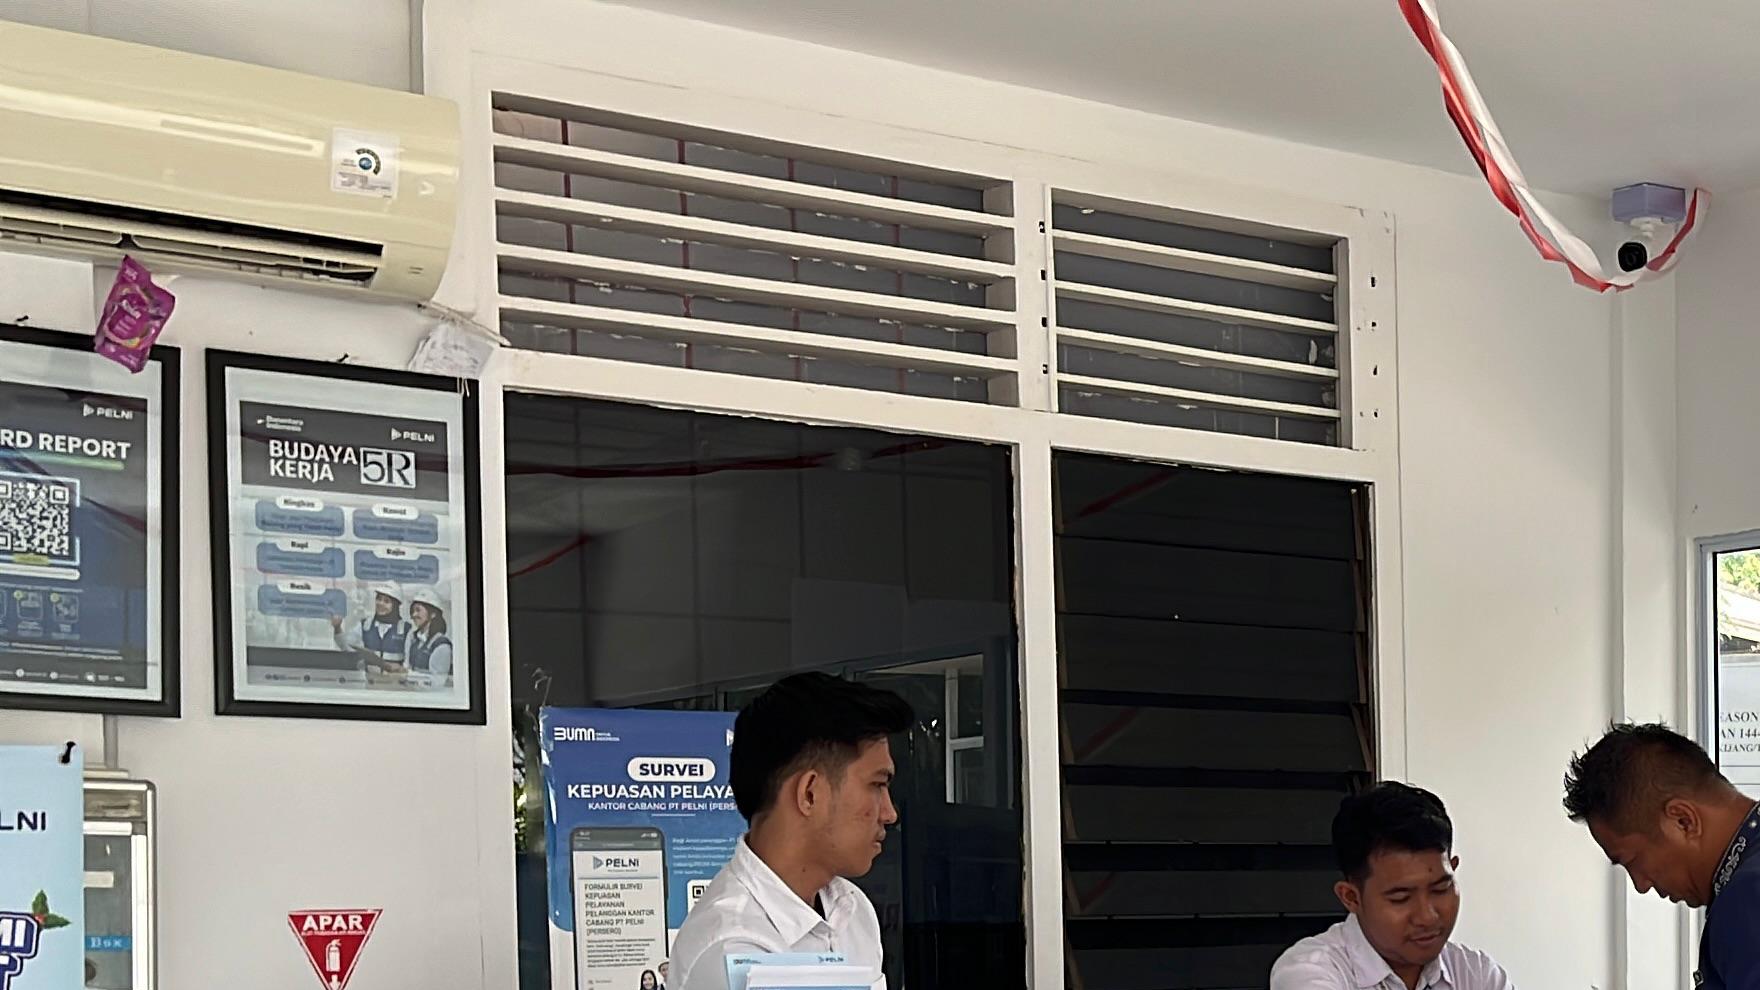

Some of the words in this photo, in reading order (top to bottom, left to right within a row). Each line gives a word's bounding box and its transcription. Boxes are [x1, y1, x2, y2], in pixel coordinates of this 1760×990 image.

[97, 406, 133, 420] PELNI
[403, 430, 435, 442] PELNI
[38, 432, 131, 460] REPORT
[269, 440, 358, 466] BUDAYA
[270, 459, 334, 483] KERJA
[363, 450, 413, 486] 5R
[639, 763, 704, 777] SURVEI
[567, 784, 665, 798] KEPUASAN
[670, 784, 735, 799] PELAYA
[588, 802, 626, 810] KANTOR
[627, 802, 666, 810] CABANG
[605, 857, 639, 868] PELNI
[302, 914, 363, 931] APAR
